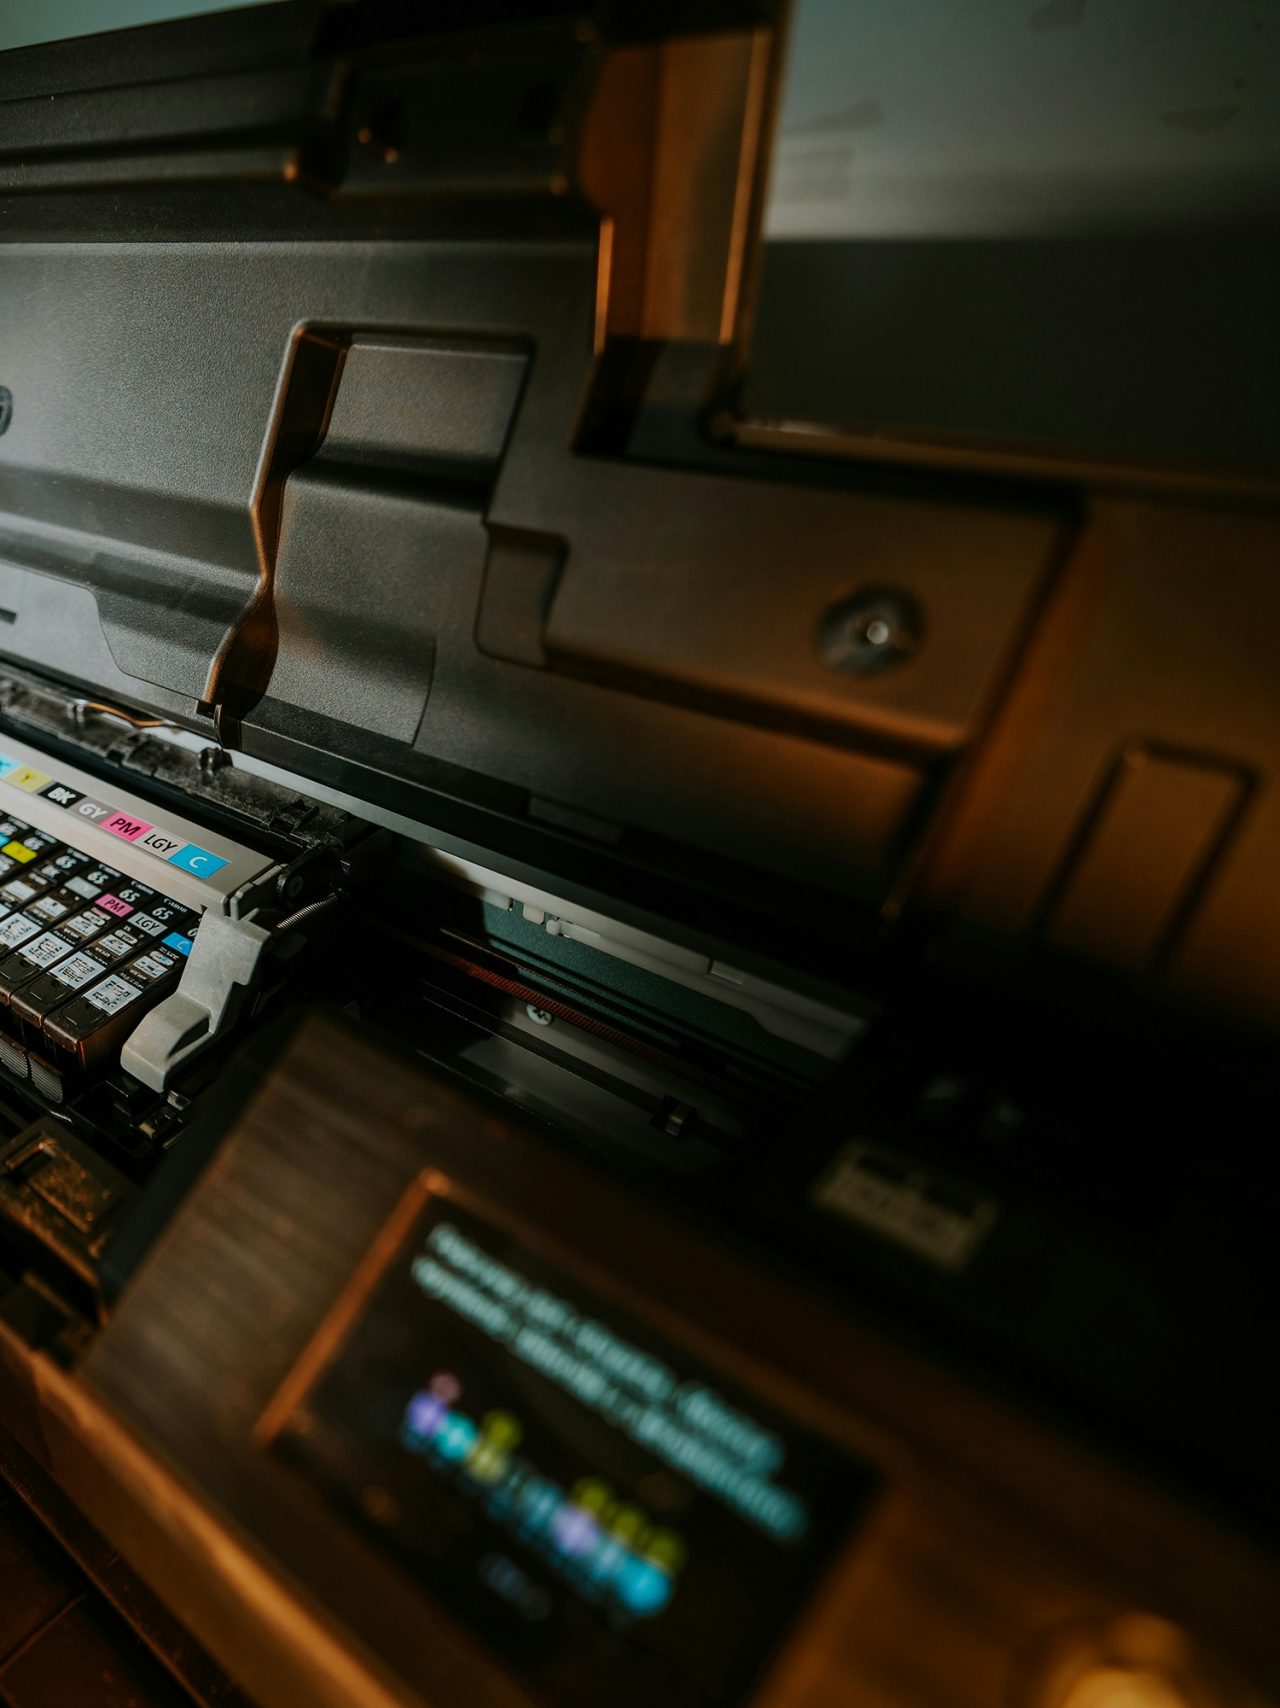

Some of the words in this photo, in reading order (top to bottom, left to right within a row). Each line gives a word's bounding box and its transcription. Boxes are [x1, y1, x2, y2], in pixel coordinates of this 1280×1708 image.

[47, 786, 77, 804] BK
[78, 802, 109, 819] GY
[109, 817, 143, 836] PM
[143, 833, 178, 853] LGY
[188, 856, 208, 869] C
[55, 855, 77, 869] 65
[87, 871, 109, 884] 65
[118, 889, 140, 902] 65
[104, 899, 126, 913] PM
[151, 907, 174, 920] 65
[135, 916, 161, 931] LGY
[187, 927, 199, 937] 6
[176, 941, 190, 950] C
